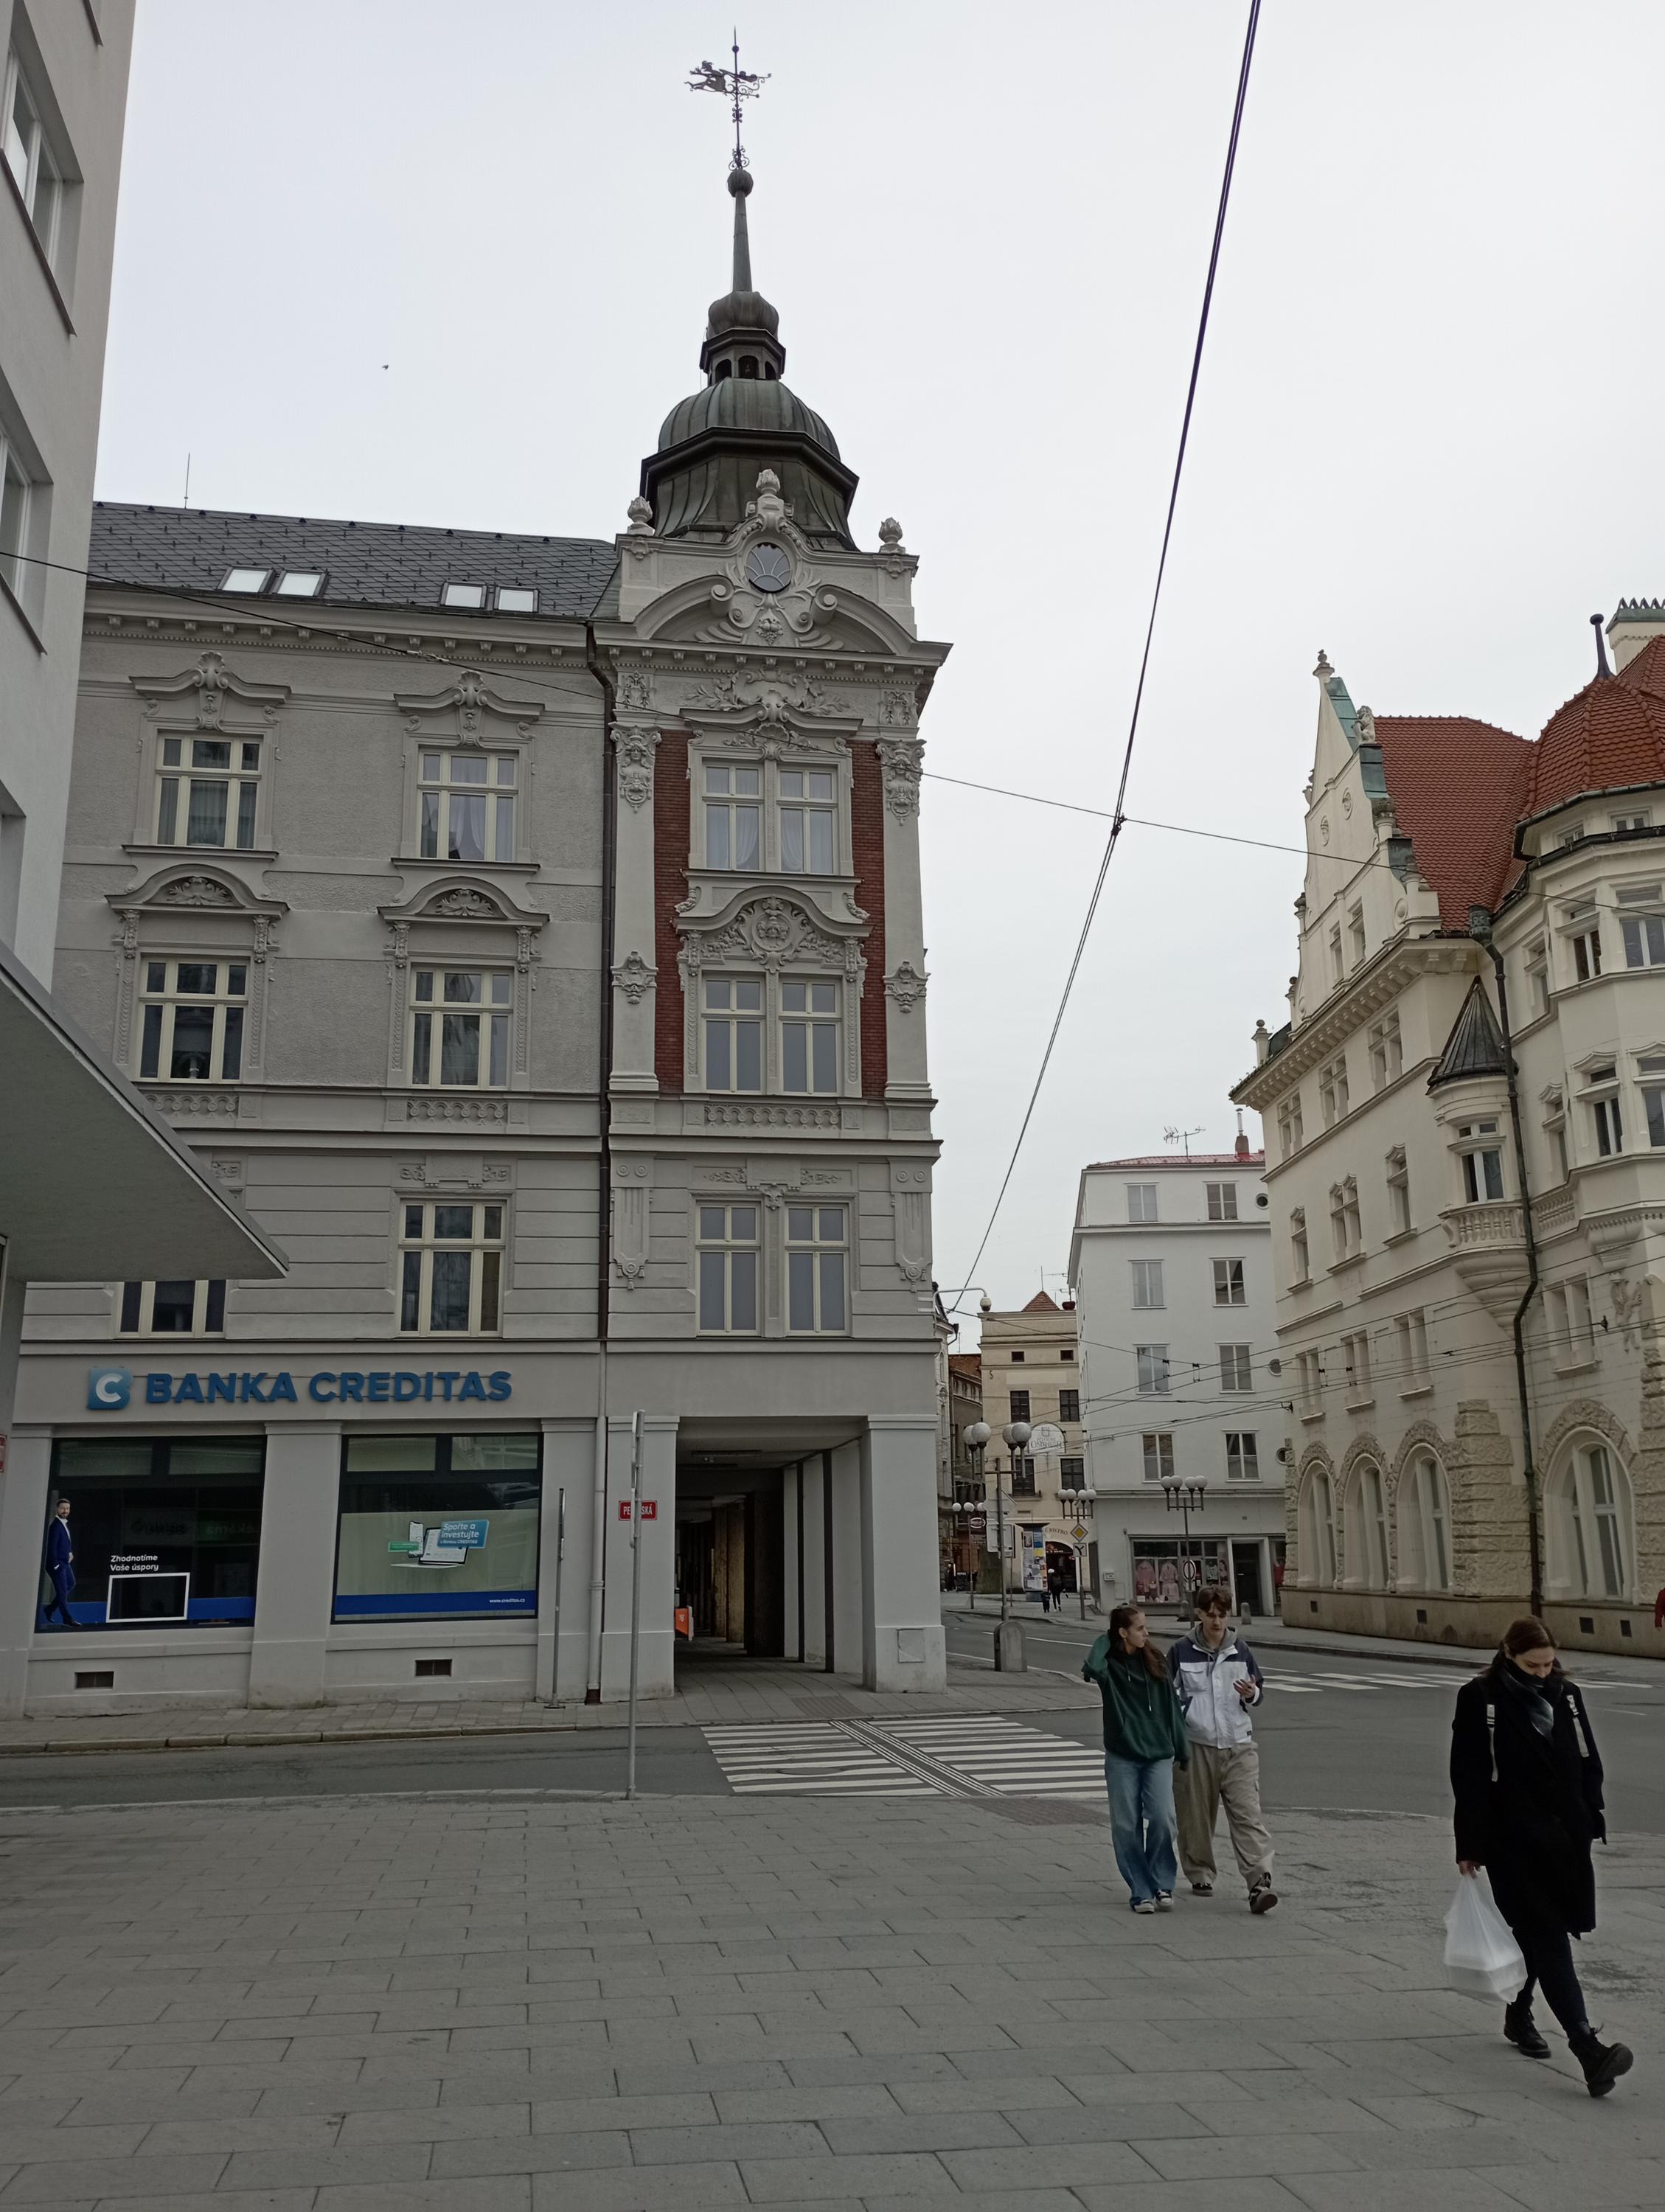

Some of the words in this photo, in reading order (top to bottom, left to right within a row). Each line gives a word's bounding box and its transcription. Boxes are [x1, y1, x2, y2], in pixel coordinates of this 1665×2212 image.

[147, 1372, 297, 1404] BANKA
[310, 1371, 512, 1402] CREDITAS
[623, 1504, 653, 1516] PESKÁ
[441, 1530, 479, 1540] investujte
[111, 1554, 158, 1562] Zhodnotíme
[131, 1563, 159, 1572] úspory
